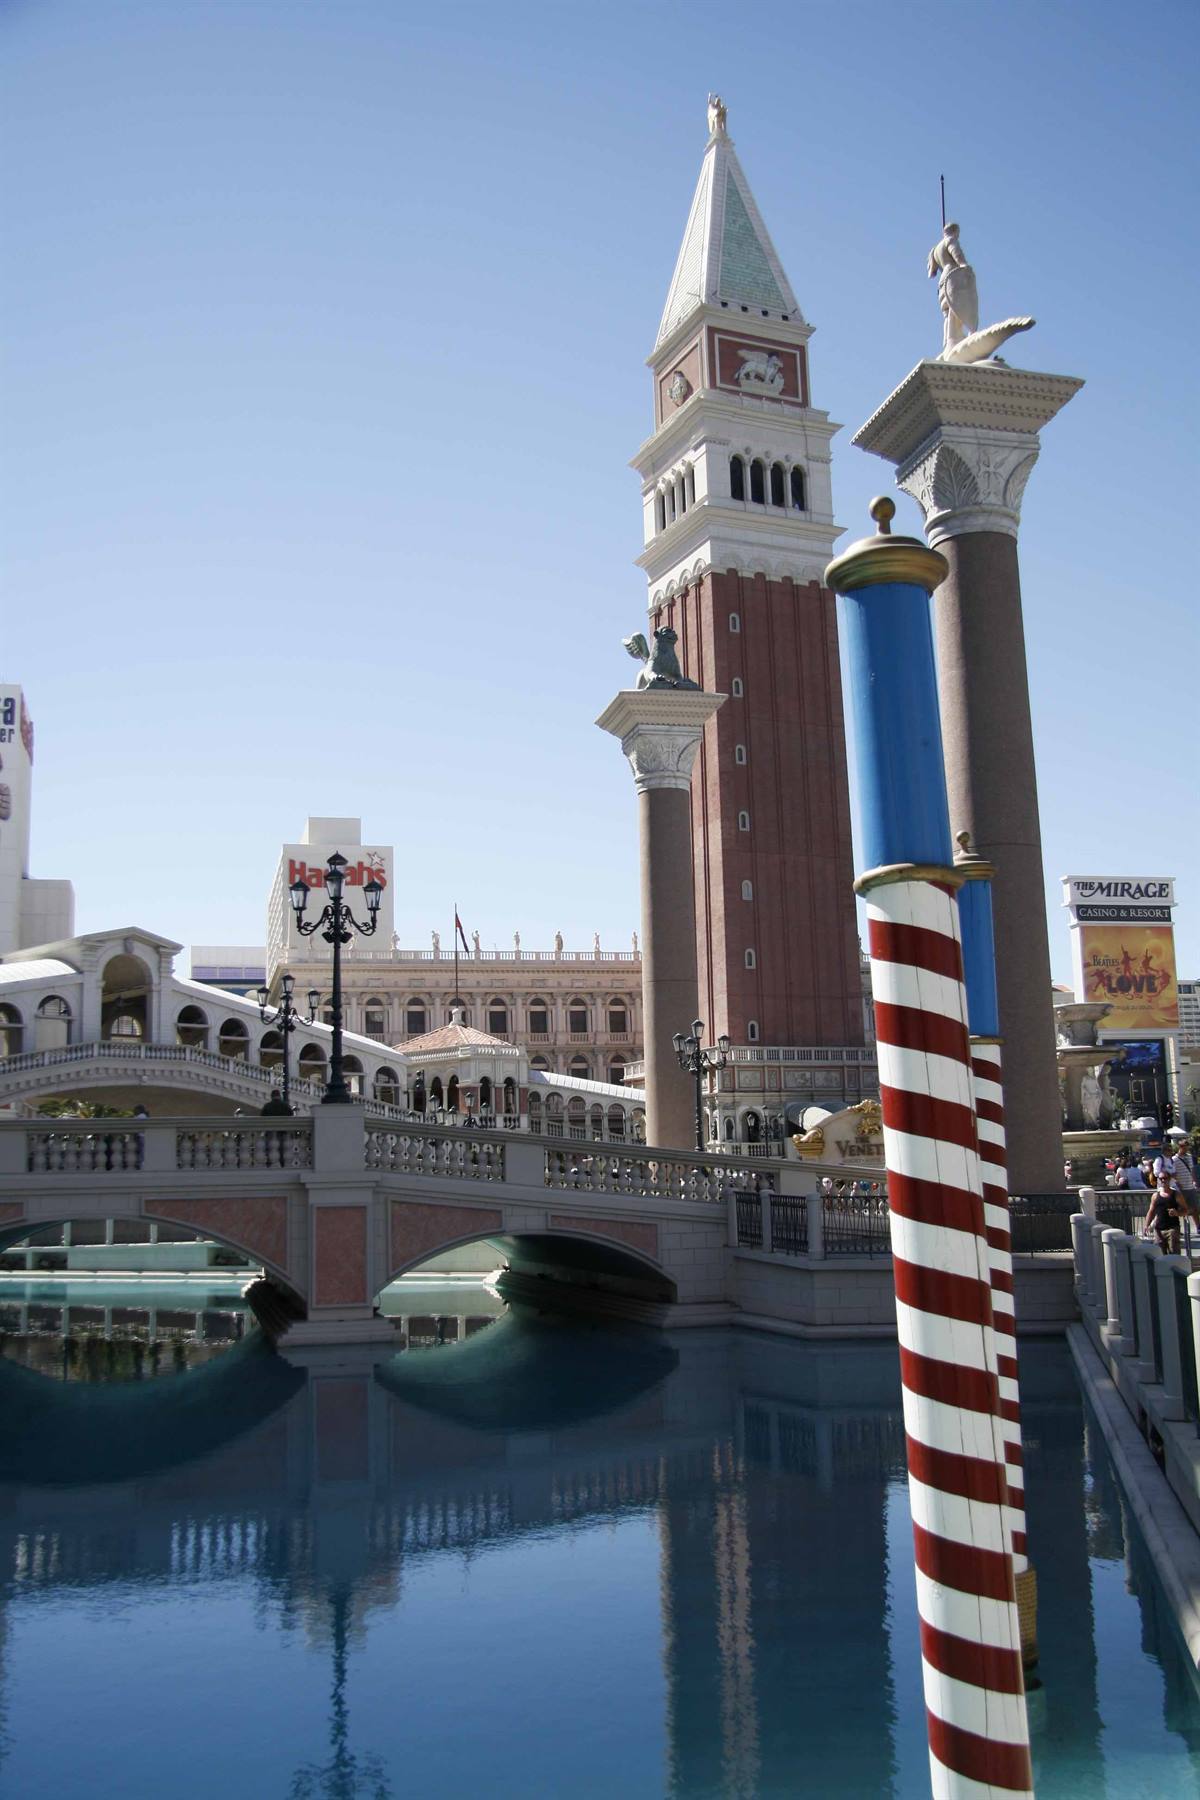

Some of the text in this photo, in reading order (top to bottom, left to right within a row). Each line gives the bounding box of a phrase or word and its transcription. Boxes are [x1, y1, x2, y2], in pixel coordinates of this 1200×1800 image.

[288, 859, 387, 890] Haahs
[1074, 881, 1169, 900] THE MIRAGE
[1079, 908, 1170, 918] CASINO & RESORT
[1093, 954, 1120, 967] BEATLES
[1107, 975, 1158, 993] LOVE
